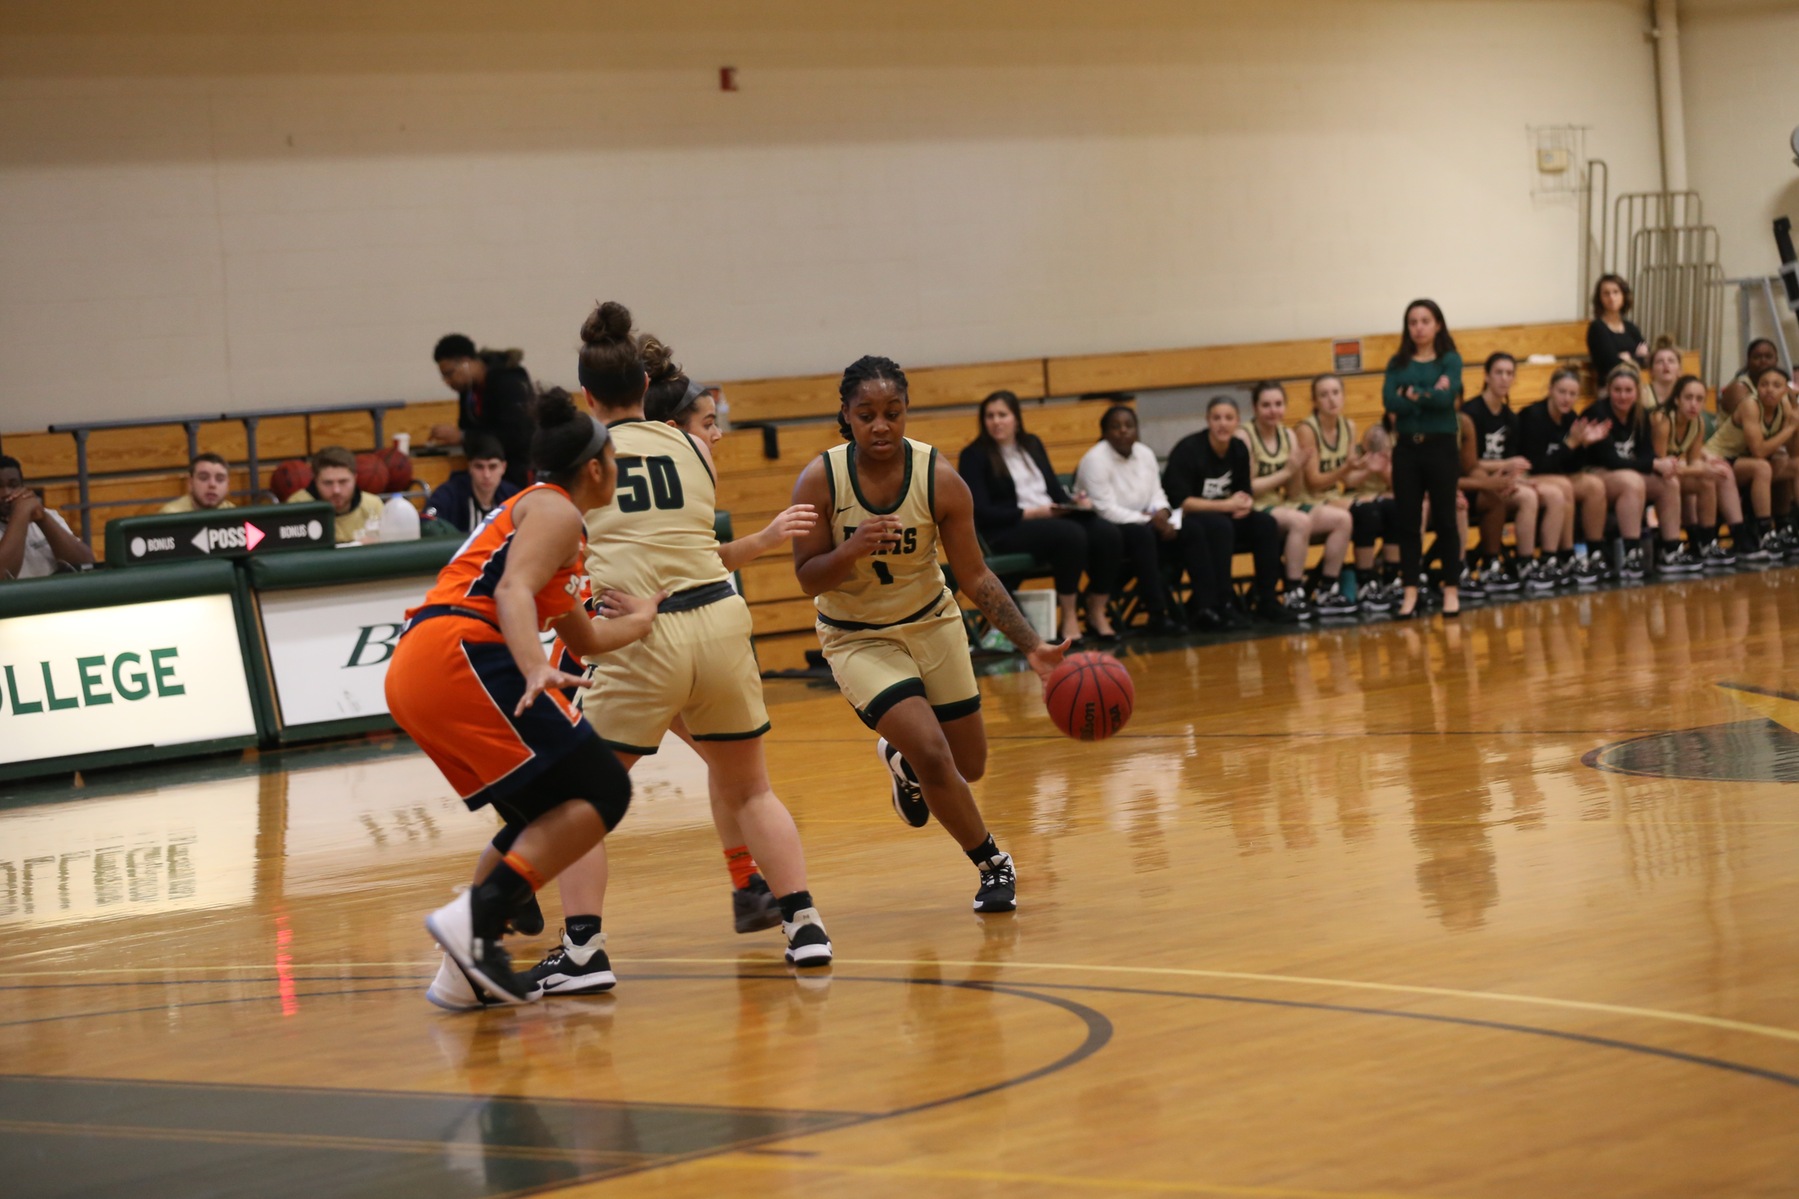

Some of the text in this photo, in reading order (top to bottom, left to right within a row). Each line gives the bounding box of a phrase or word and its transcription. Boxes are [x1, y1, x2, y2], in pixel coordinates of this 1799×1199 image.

[614, 455, 684, 513] 50
[147, 524, 307, 552] BONUS POSS BONUS
[872, 560, 894, 585] 1
[0, 647, 186, 716] LLEGE
